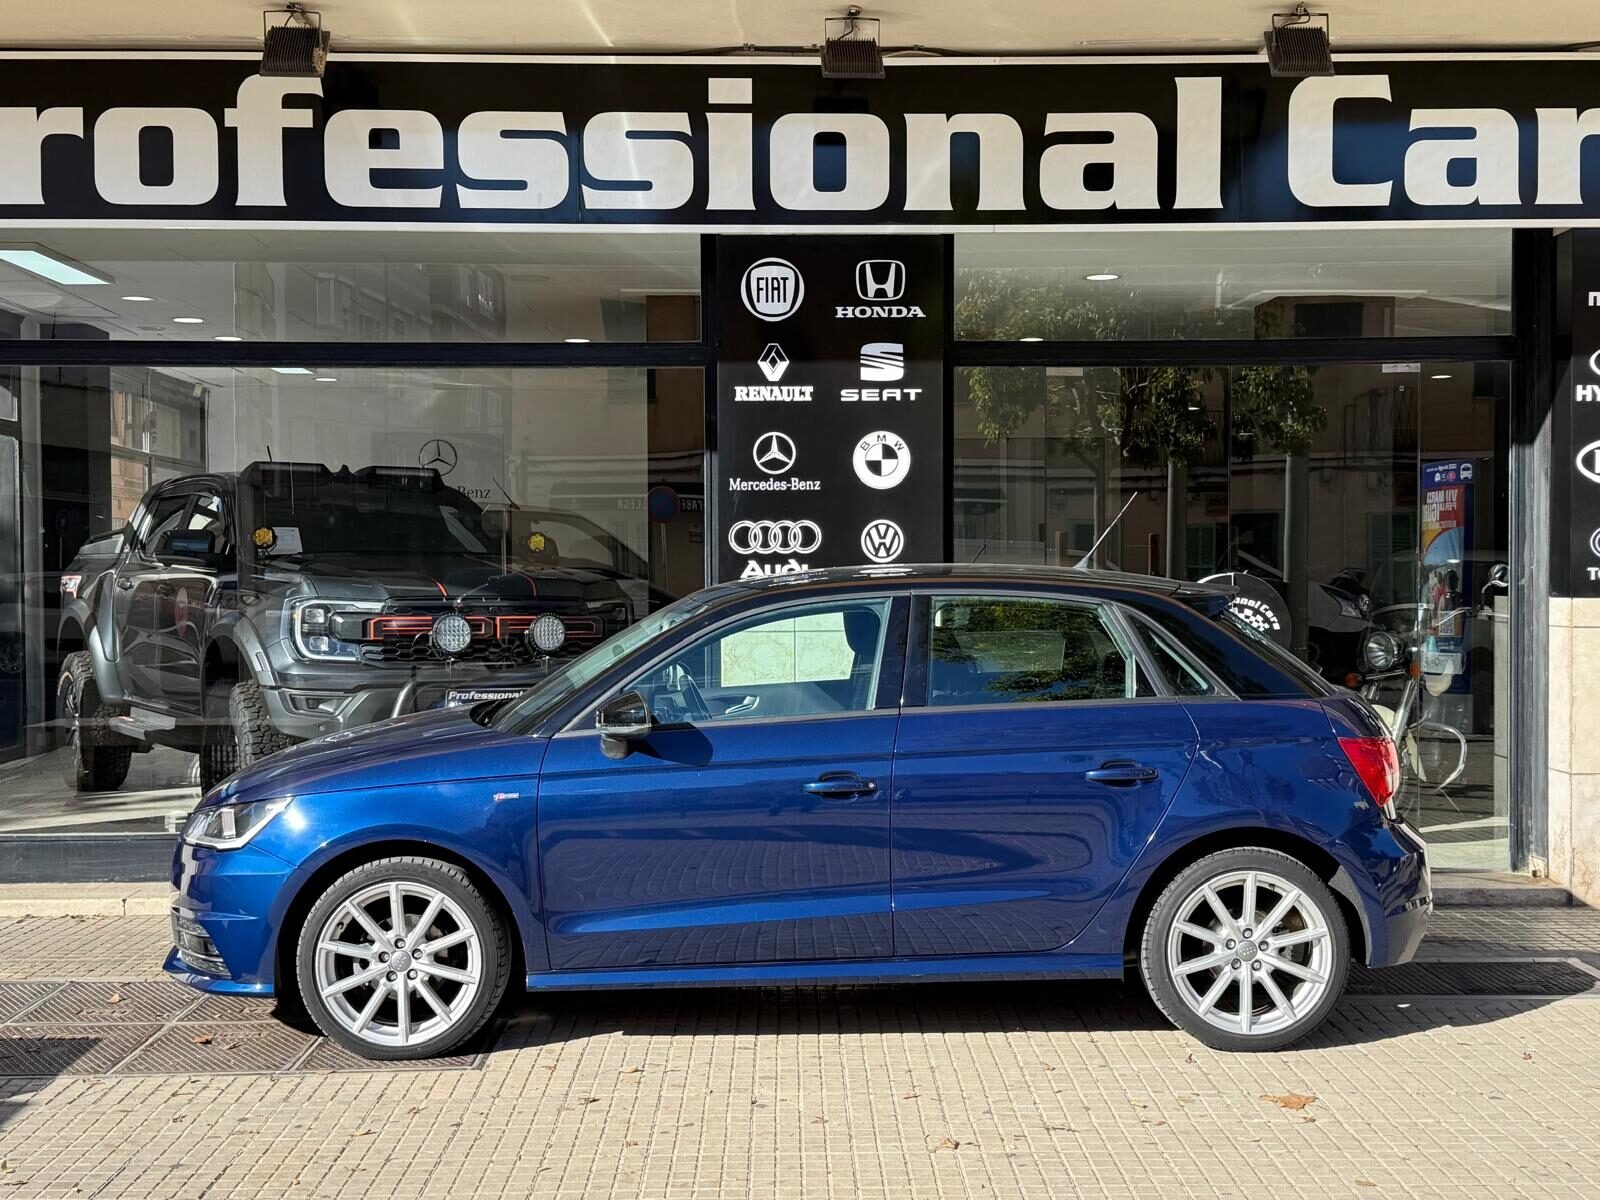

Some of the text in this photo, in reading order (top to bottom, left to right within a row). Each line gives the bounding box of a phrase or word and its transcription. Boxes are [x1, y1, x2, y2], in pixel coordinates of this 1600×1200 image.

[756, 276, 789, 304] FIAT
[835, 305, 926, 318] HONDA
[734, 385, 814, 402] RENAULT
[840, 388, 923, 402] SEAT
[859, 433, 905, 452] BMW
[728, 477, 821, 491] Mercedes-Benz
